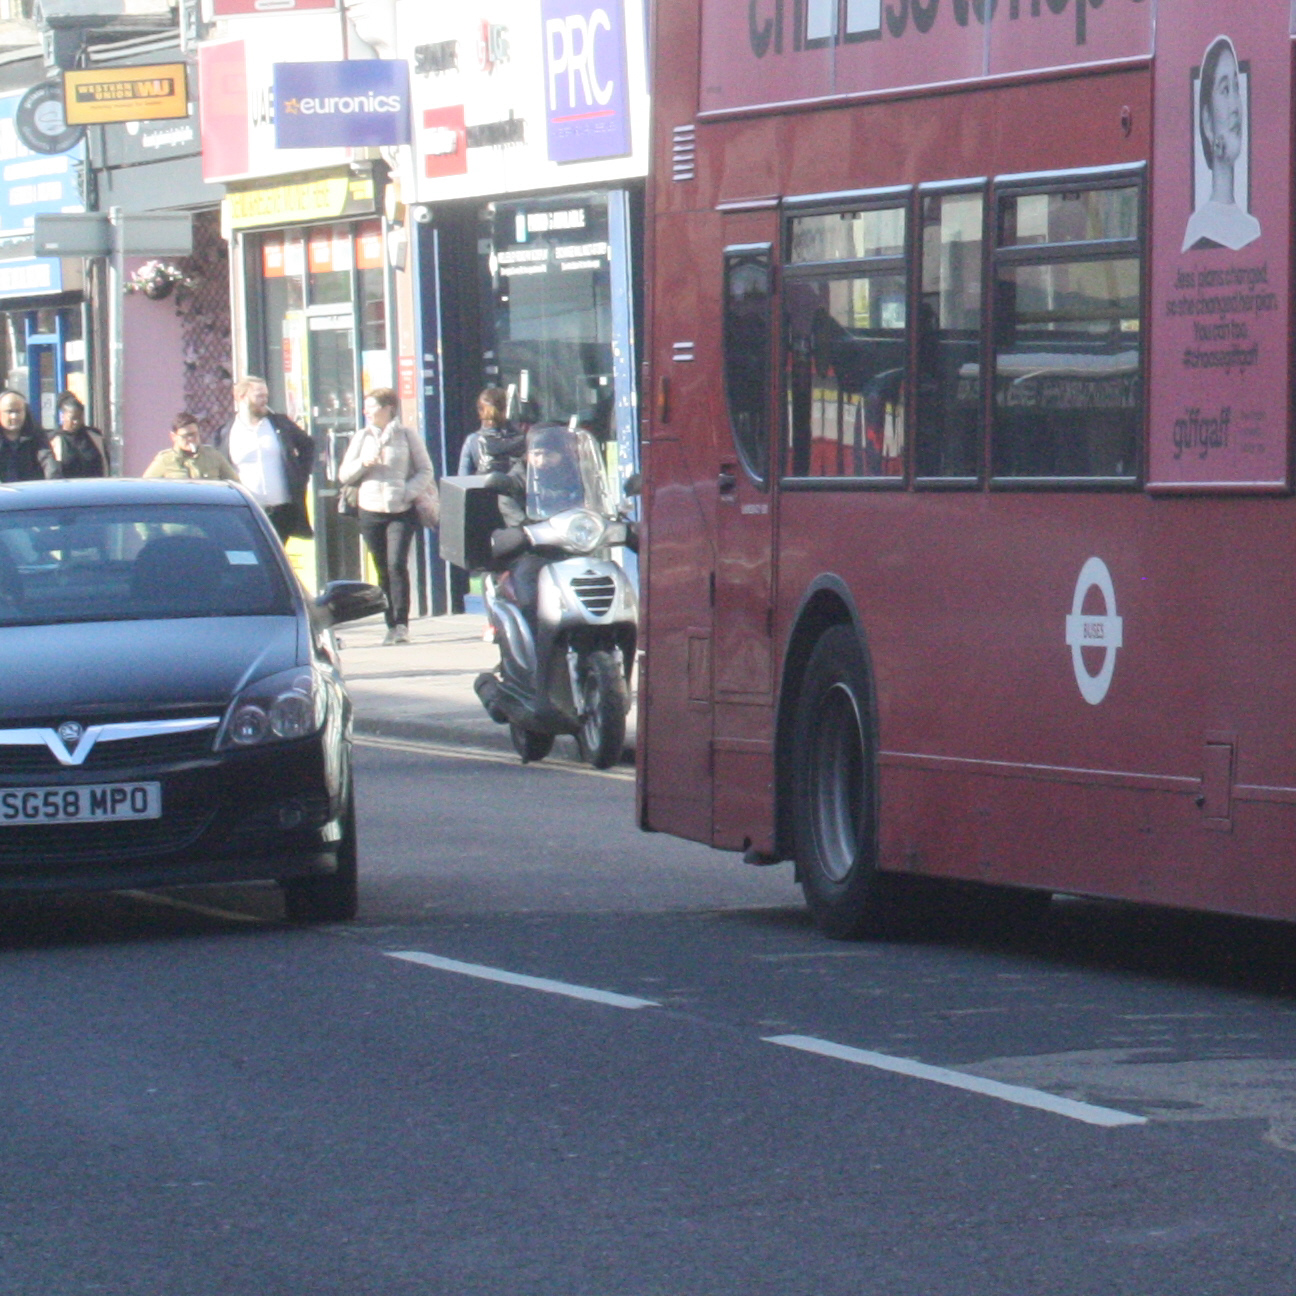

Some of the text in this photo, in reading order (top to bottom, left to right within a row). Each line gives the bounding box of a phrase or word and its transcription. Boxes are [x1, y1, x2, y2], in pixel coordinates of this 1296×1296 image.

[546, 8, 614, 111] PRC
[77, 81, 133, 93] WESTERN
[95, 91, 133, 101] UNION
[300, 91, 401, 114] euronics
[1, 787, 148, 819] SG58 MPO
